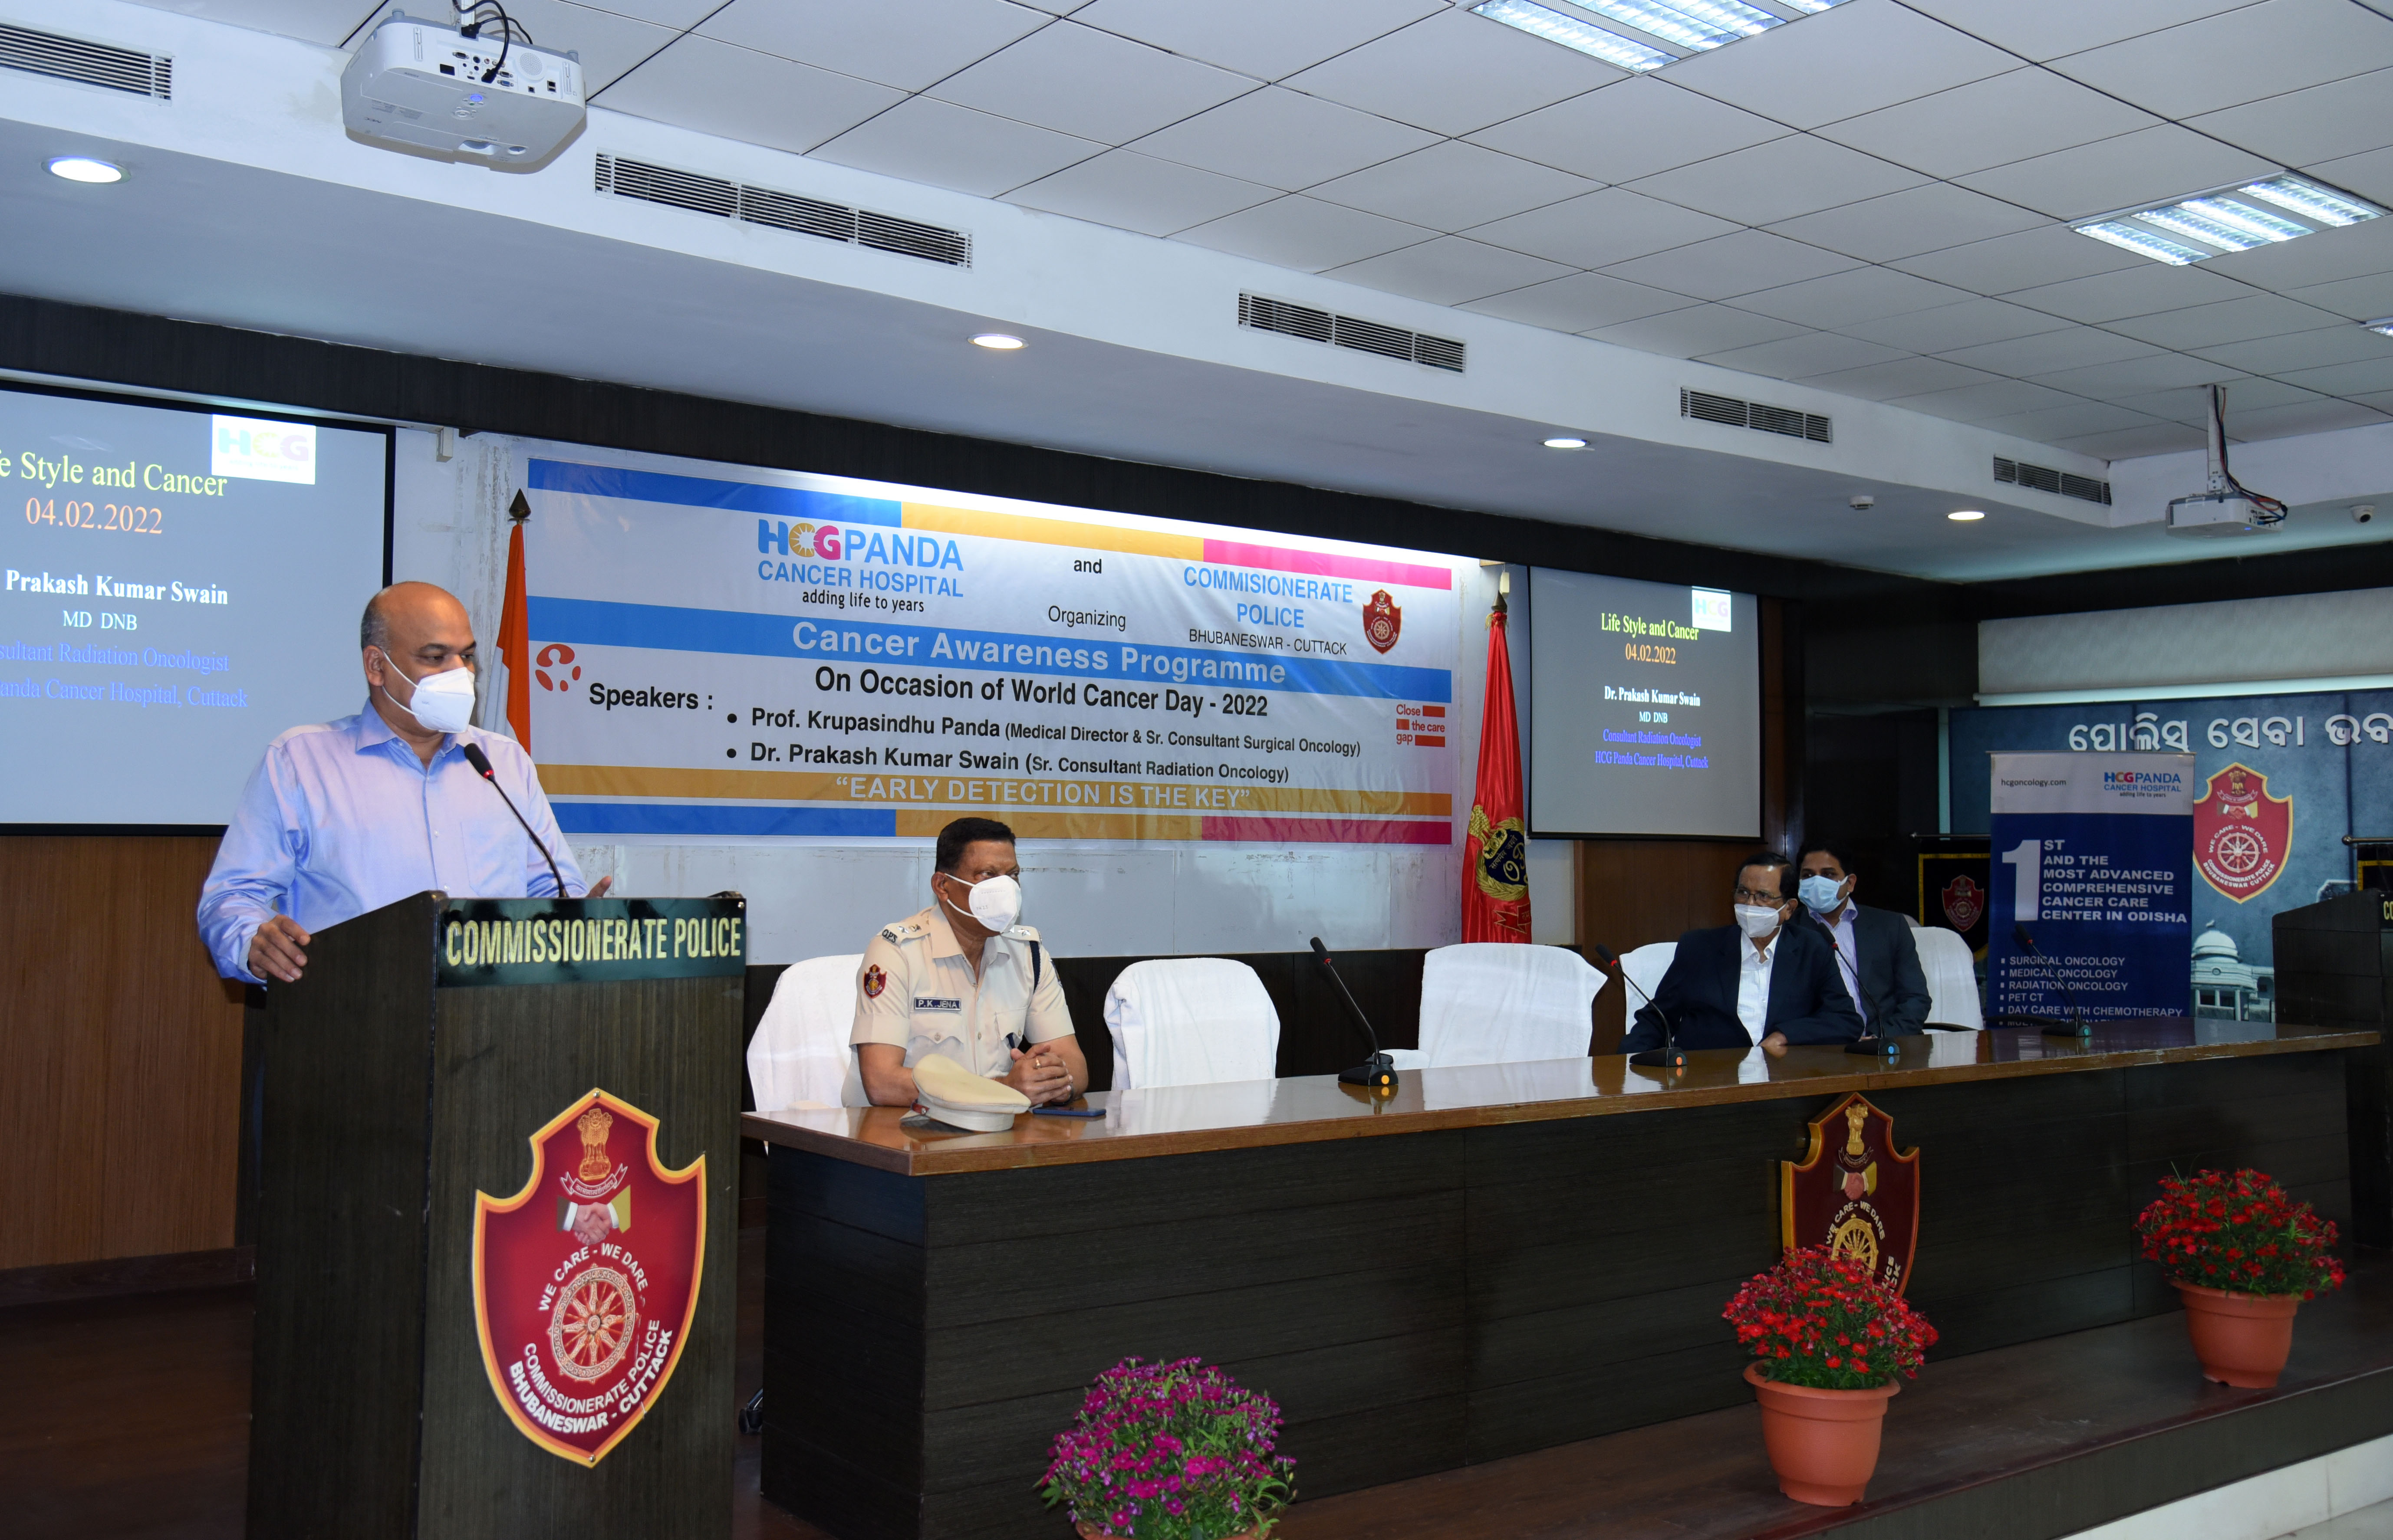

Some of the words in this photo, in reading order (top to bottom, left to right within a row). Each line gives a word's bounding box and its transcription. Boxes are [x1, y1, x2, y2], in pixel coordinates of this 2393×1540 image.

[21, 451, 84, 489] Style
[93, 462, 135, 488] and
[144, 462, 227, 496] Cancer
[26, 498, 163, 535] 04.02.2022
[758, 560, 852, 588] CANCER
[859, 569, 964, 598] HOSPITAL
[1073, 558, 1102, 575] and
[5, 569, 89, 595] Prakash
[96, 575, 166, 601] Kumar
[171, 581, 229, 605] Swain
[1184, 566, 1353, 604] COMMISIONERATE
[802, 589, 845, 608] adding
[848, 592, 870, 609] life
[875, 595, 888, 610] to
[892, 597, 925, 613] years
[63, 610, 92, 628] MD
[101, 613, 138, 631] DNB
[1048, 605, 1126, 632] Organizing
[1237, 603, 1304, 628] POLICE
[1601, 613, 1620, 633] Life
[1623, 615, 1646, 638] Style
[1649, 619, 1666, 637] and
[1668, 621, 1699, 640] Cancer
[793, 621, 919, 657] Cancer
[930, 632, 1108, 670] Awareness
[1121, 647, 1286, 684] Programme
[1189, 629, 1283, 650] BHUBANESWAR
[1294, 638, 1346, 656] CUTTACK
[1626, 643, 1676, 664] 04.02.2022
[0, 640, 53, 661] sultant
[59, 643, 138, 667] Radiation
[143, 646, 230, 675] Oncologist
[0, 677, 40, 699] anda
[46, 679, 105, 702] Cancer
[110, 682, 183, 708] Hospital,
[187, 686, 248, 709] Cuttack
[589, 683, 699, 710] Speakers
[816, 666, 850, 692] On
[860, 669, 974, 699] Occasion
[981, 682, 1005, 699] of
[1012, 682, 1076, 706] World
[1083, 684, 1159, 711] Cancer
[1165, 689, 1204, 719] Day
[1222, 694, 1268, 717] 2022
[1604, 686, 1617, 700] Dr.
[1619, 686, 1649, 703] Prakash
[1652, 690, 1678, 705] Kumar
[1679, 692, 1700, 706] Swain
[1396, 704, 1421, 716] Close
[1639, 711, 1651, 722] MD
[1654, 712, 1668, 723] DNB
[751, 707, 800, 728] Prof.
[808, 710, 935, 735] Krupasindhu
[941, 717, 1000, 738] Panda
[1005, 721, 1067, 742] (Medical
[1071, 726, 1129, 744] Director
[1132, 729, 1141, 744] &
[1146, 730, 1163, 745] Sr.
[1167, 731, 1240, 749] Consultant
[1244, 735, 1295, 754] Surgical
[1298, 739, 1361, 758] Oncology)
[1396, 732, 1413, 745] gap
[1412, 720, 1425, 731] the
[1427, 723, 1445, 732] care
[2207, 716, 2304, 749] ସେବା
[2325, 713, 2393, 745] ଭବ
[1603, 729, 1637, 743] Consultant
[1638, 730, 1668, 745] Radiation
[1669, 732, 1702, 749] Oncologist
[750, 742, 781, 763] Dr.
[789, 744, 878, 765] Prakash
[885, 747, 953, 768] Kumar
[958, 752, 1018, 771] Swain
[1025, 752, 1053, 774] (Sr.
[1058, 757, 1142, 775] Consultant
[1146, 760, 1214, 778] Radiation
[1218, 763, 1290, 784] Oncology)
[1595, 750, 1613, 764] HCG
[1613, 752, 1633, 765] Panda
[1634, 752, 1656, 766] Cancer
[1657, 753, 1684, 769] Hospital,
[1685, 755, 1708, 768] Cuttack
[948, 779, 1099, 804] DETECTION
[1110, 785, 1132, 805] IS
[1141, 786, 1186, 806] THE
[2001, 778, 2066, 788] hcgoncology.com
[2044, 840, 2065, 850] ST
[2209, 837, 2216, 854] WE
[2214, 825, 2234, 839] CARE
[2255, 831, 2268, 854] DARE
[2044, 856, 2074, 865] AND
[2079, 856, 2108, 865] THE
[2208, 859, 2255, 882] COMMISSIONERATE
[2255, 859, 2271, 877] POLICE
[2044, 869, 2085, 879] MOST
[2090, 870, 2174, 880] ADVANCED
[2203, 862, 2248, 888] BHUBANESWAR
[2250, 864, 2275, 886] CUTTACK
[2043, 883, 2174, 894] COMPREHENSIVE
[2042, 896, 2103, 906] CANCER
[2108, 897, 2149, 907] CARE
[2042, 910, 2102, 920] CENTER
[2107, 912, 2122, 921] IN
[2128, 912, 2187, 923] ODISHA
[446, 918, 668, 967] COMMISSIONERATE
[674, 917, 741, 959] POLICE
[2009, 956, 2061, 966] SURGICAL
[2065, 957, 2125, 966] ONCOLOGY
[2009, 968, 2054, 978] MEDICAL
[2058, 969, 2117, 978] ONCOLOGY
[2009, 981, 2064, 990] RADIATION
[2067, 982, 2128, 991] ONCOLOGY
[2030, 993, 2044, 1002] CT
[2008, 1005, 2028, 1015] DAY
[2031, 1005, 2061, 1015] CARE
[2064, 1006, 2090, 1015] WTH
[2093, 1007, 2182, 1017] CHEMOTHERAPY
[1826, 1224, 1837, 1245] WE
[1834, 1202, 1853, 1224] CARE
[1860, 1201, 1871, 1213] WE
[1870, 1208, 1885, 1241] DARE
[539, 1281, 558, 1312] WE
[554, 1245, 590, 1282] CARE
[601, 1243, 622, 1260] WE
[621, 1251, 648, 1291] DARE
[523, 1342, 629, 1414] COMMISSIONERATE
[628, 1319, 661, 1379] POLICE
[510, 1360, 609, 1434] BHUBANESWAR
[619, 1329, 674, 1412] CUTTACK
